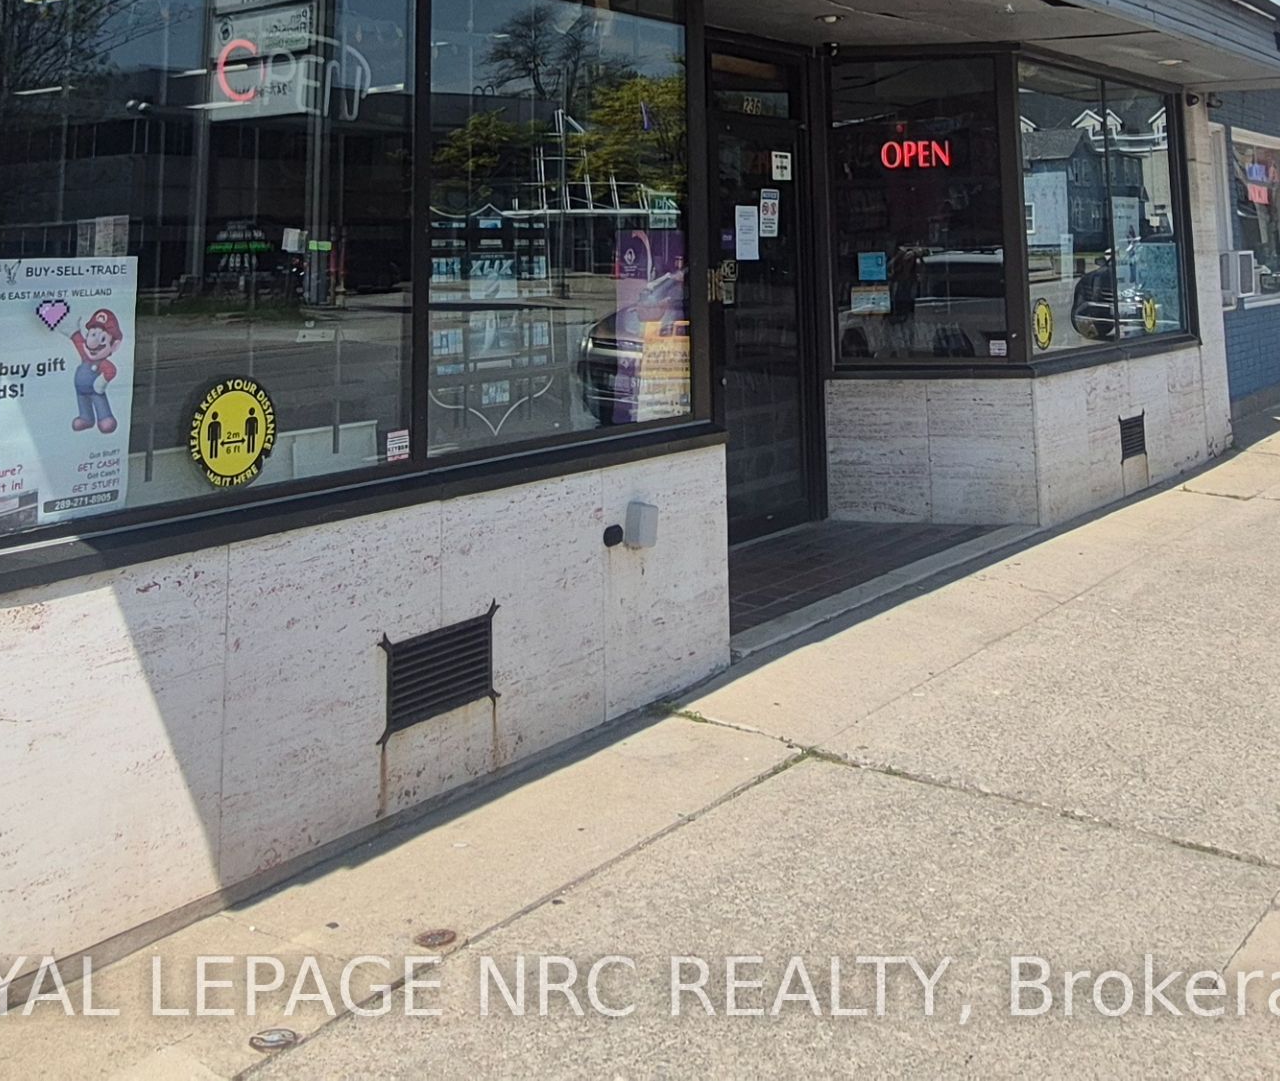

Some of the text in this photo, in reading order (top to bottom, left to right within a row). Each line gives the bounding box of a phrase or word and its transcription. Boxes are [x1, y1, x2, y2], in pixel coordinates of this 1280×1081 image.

[742, 96, 762, 115] 236
[880, 139, 952, 169] OPEN
[8, 290, 31, 300] EAST
[33, 289, 55, 299] MAIN
[71, 287, 113, 298] WELLAND
[36, 357, 66, 376] gift
[190, 378, 275, 461] PLEASE KEEP YOUR DISTANCE
[226, 431, 240, 440] 2m
[225, 446, 241, 455] 6 ft
[77, 462, 94, 472] GET
[206, 464, 259, 487] WAIT HERE
[11, 480, 24, 494] in!
[72, 483, 89, 494] GET
[53, 492, 112, 511] 289-271-8905
